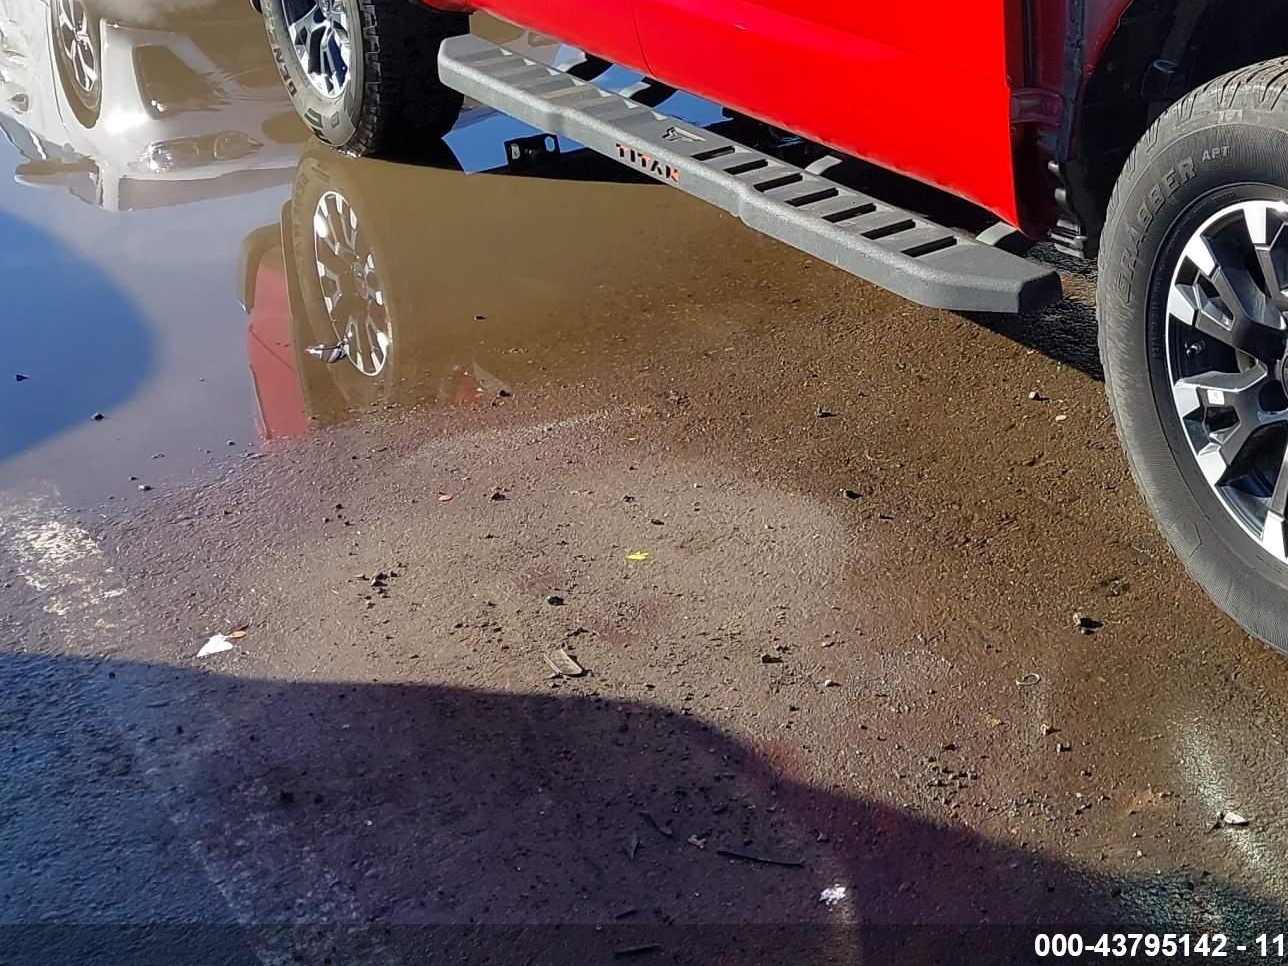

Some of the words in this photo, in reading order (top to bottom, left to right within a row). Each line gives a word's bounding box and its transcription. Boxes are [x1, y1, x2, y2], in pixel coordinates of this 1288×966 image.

[615, 143, 681, 182] TITAN
[1117, 156, 1199, 304] GRABBER
[1201, 144, 1231, 163] APT
